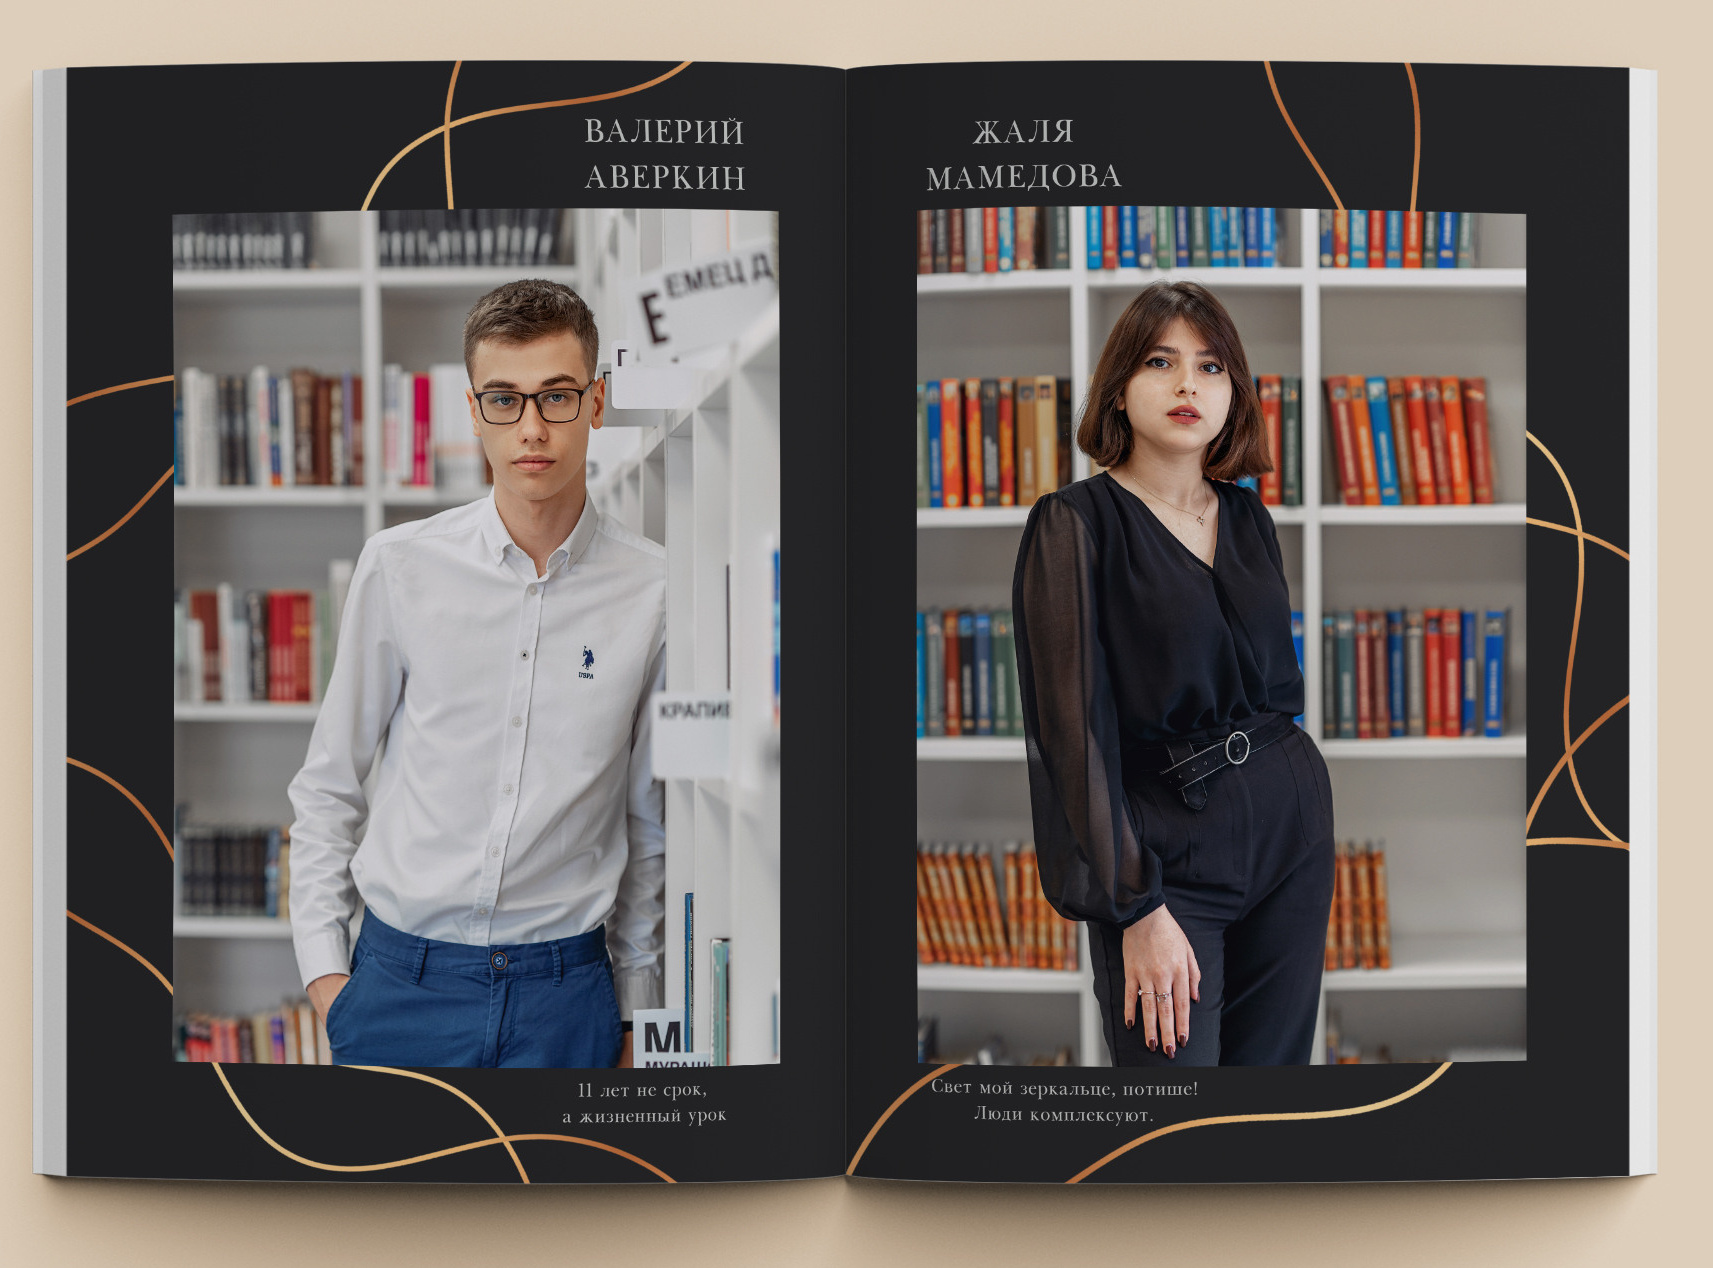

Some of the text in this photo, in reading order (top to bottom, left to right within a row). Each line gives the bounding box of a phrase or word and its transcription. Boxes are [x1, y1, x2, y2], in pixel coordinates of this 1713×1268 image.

[584, 117, 744, 145] ВАЛЕРИЙ
[972, 119, 1074, 145] ЖАЛЯ
[584, 164, 746, 191] АВЕРКИН
[926, 163, 1123, 192] МАМЕДОВА
[665, 257, 748, 299] ЕМЕЦ
[640, 292, 669, 344] Е
[645, 1021, 681, 1053] М
[578, 1082, 707, 1102] 11 лет не срок,
[931, 1078, 1198, 1100] Свет мой зеркальце, потише!
[562, 1108, 727, 1127] а жизненный урок
[974, 1105, 1154, 1127] Люди комплексуют.
